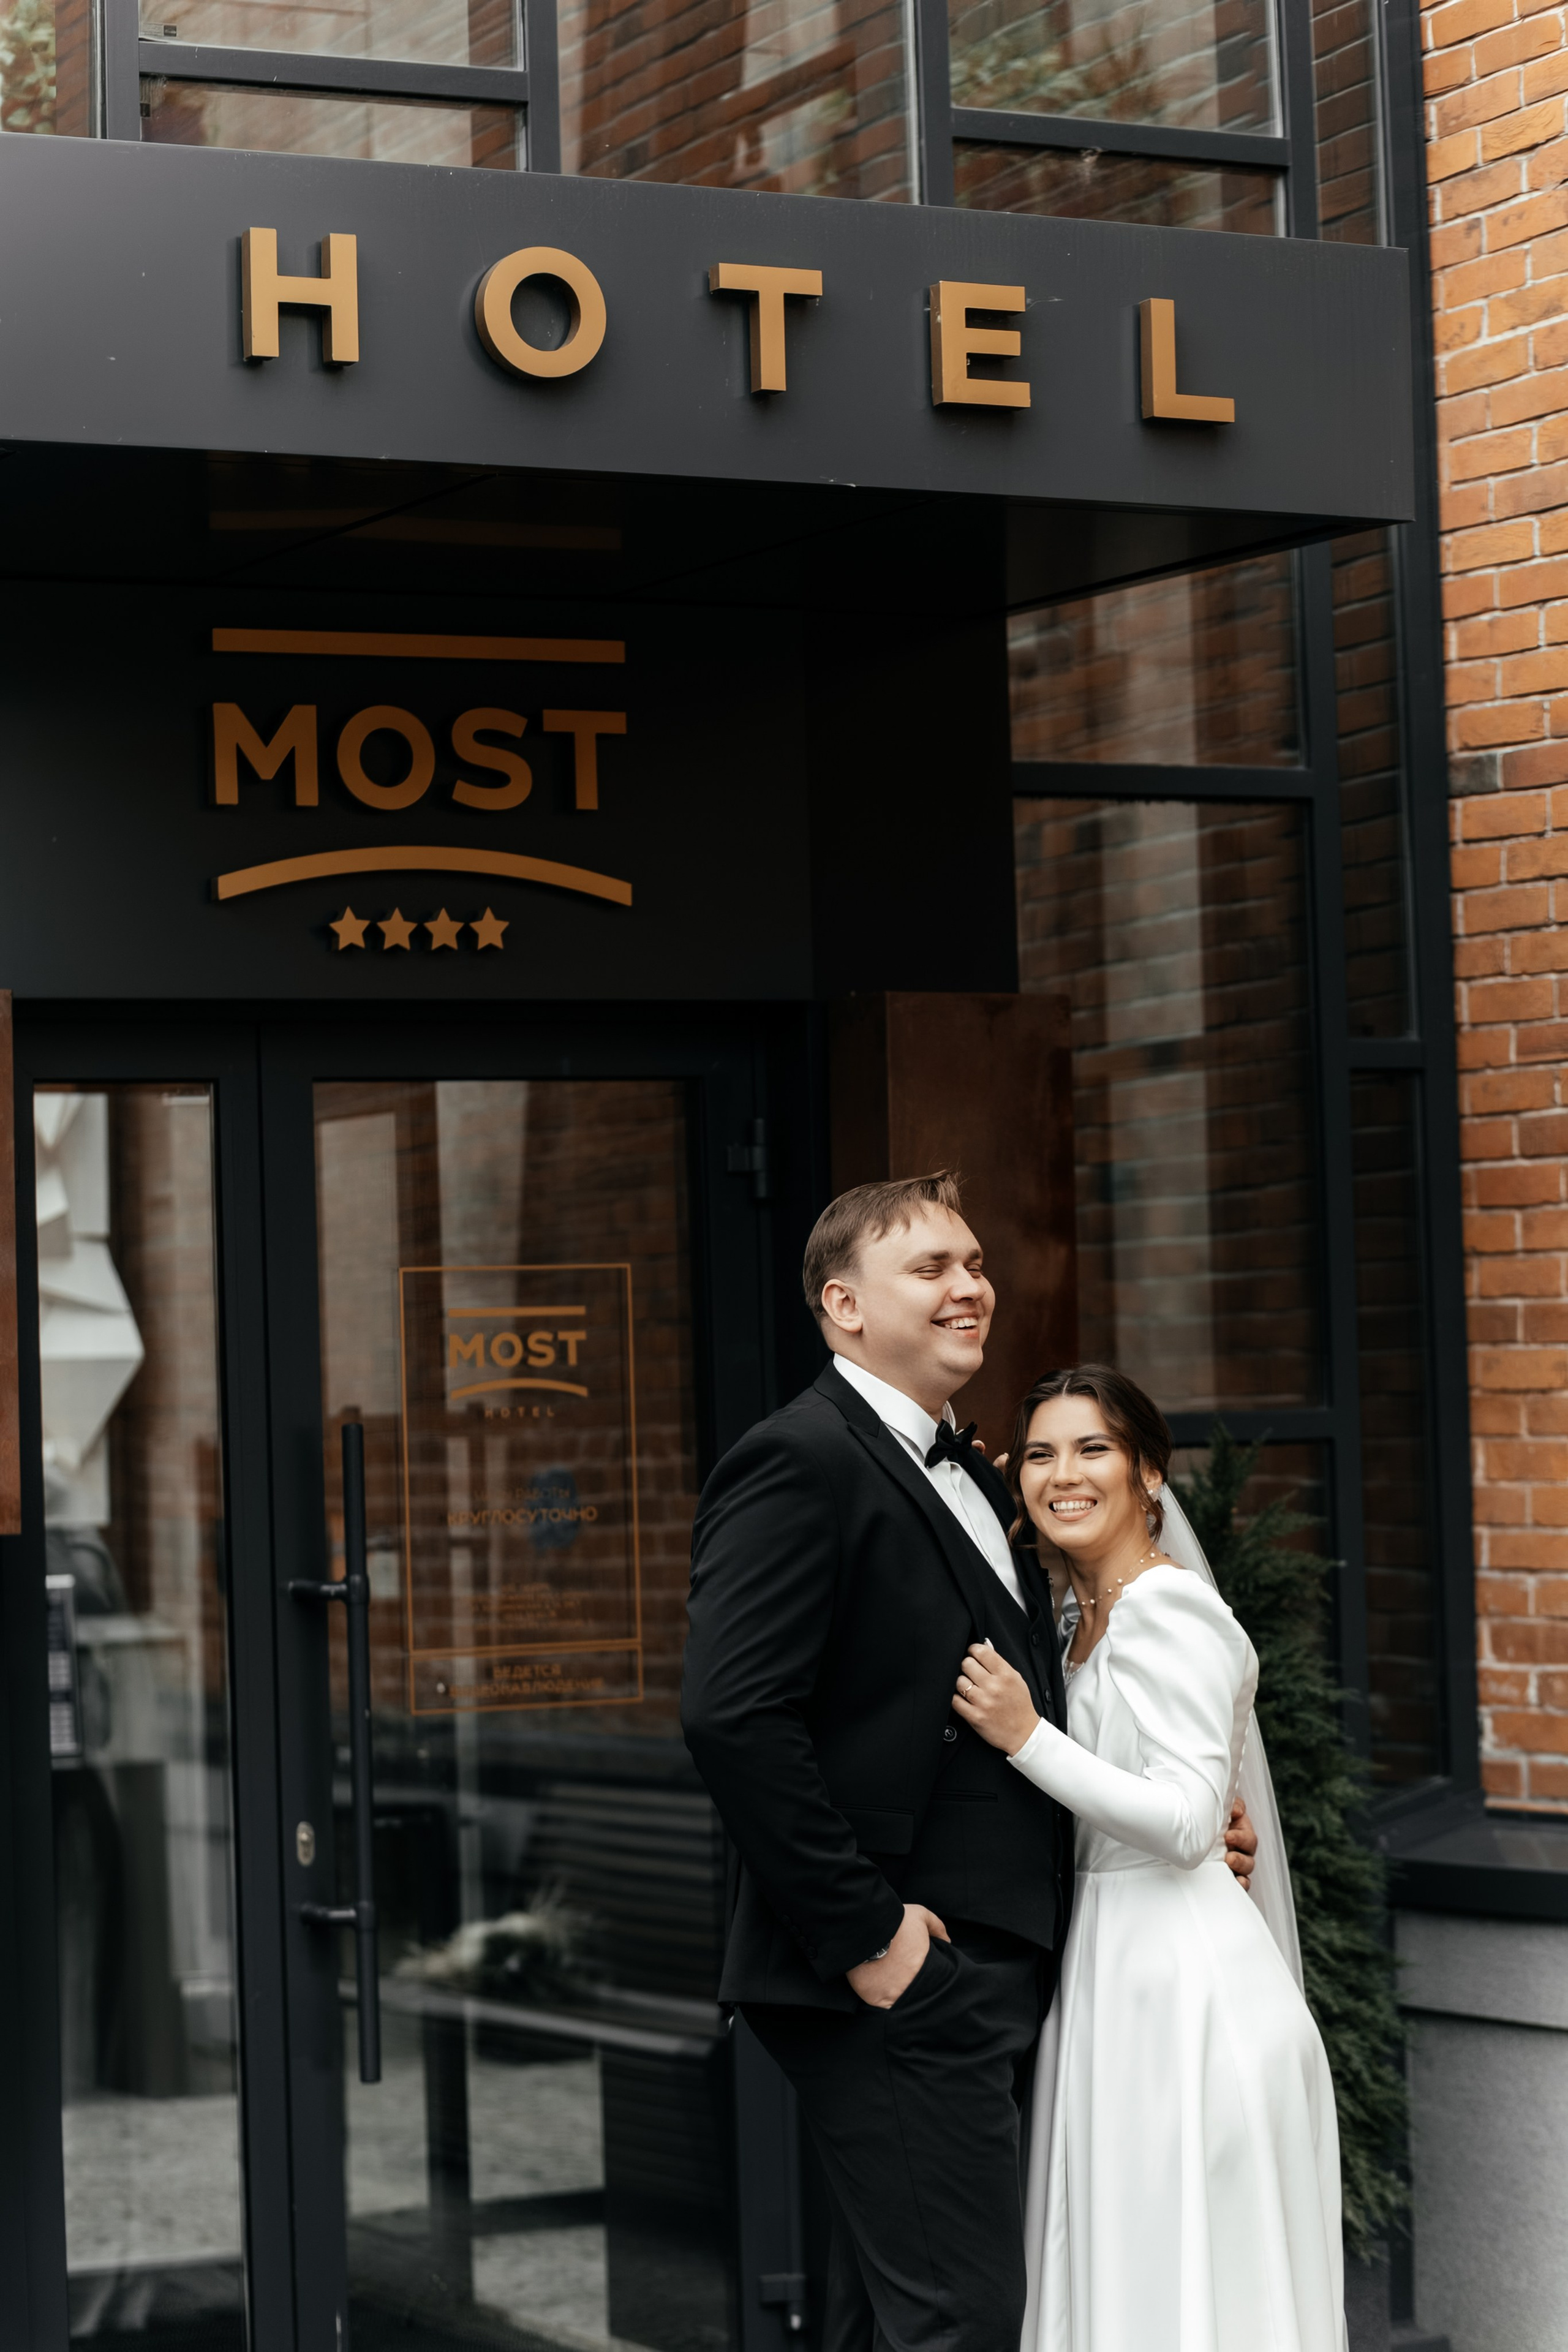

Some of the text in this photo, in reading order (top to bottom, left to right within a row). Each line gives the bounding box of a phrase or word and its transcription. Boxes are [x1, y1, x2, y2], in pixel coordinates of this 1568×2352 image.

[241, 227, 1235, 424] HOTEL
[212, 703, 627, 810] MOST
[448, 1330, 587, 1368] MOST
[484, 1404, 555, 1419] HOTEL
[447, 1506, 598, 1526] КРУГЛОСУТОЧНО
